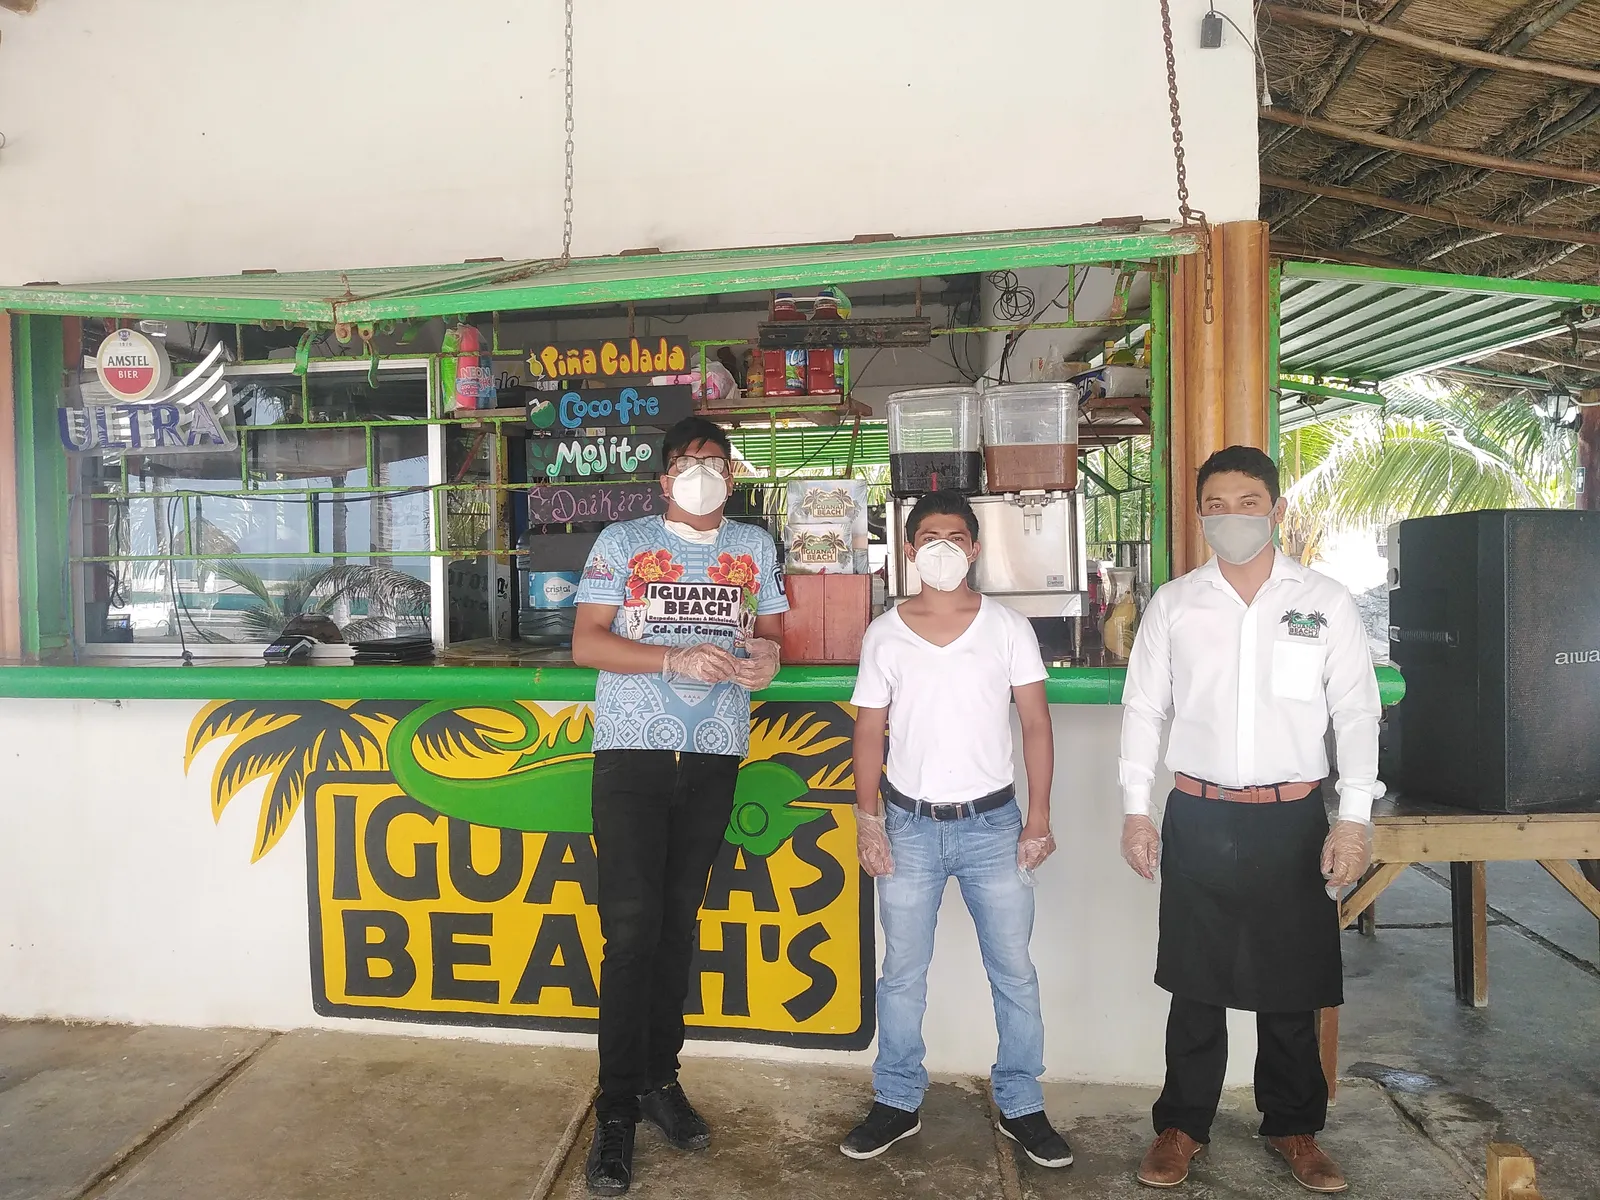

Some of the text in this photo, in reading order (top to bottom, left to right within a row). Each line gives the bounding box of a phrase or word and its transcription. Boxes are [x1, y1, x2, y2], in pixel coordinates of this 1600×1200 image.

[107, 356, 149, 366] AMSTEL
[540, 337, 686, 379] Piña Colada
[118, 370, 139, 379] BIER
[460, 366, 491, 379] NEON
[559, 387, 660, 429] Coco fre
[58, 401, 225, 451] ULTRA
[546, 436, 652, 476] Mojito
[545, 585, 571, 593] cristal
[650, 585, 739, 604] IGUANAS
[664, 600, 732, 617] BEACH
[652, 624, 734, 638] Cd. del Carmen
[1554, 649, 1600, 665] aiwa
[332, 794, 848, 916] IGUAAS
[341, 909, 838, 1024] BEAH'S
